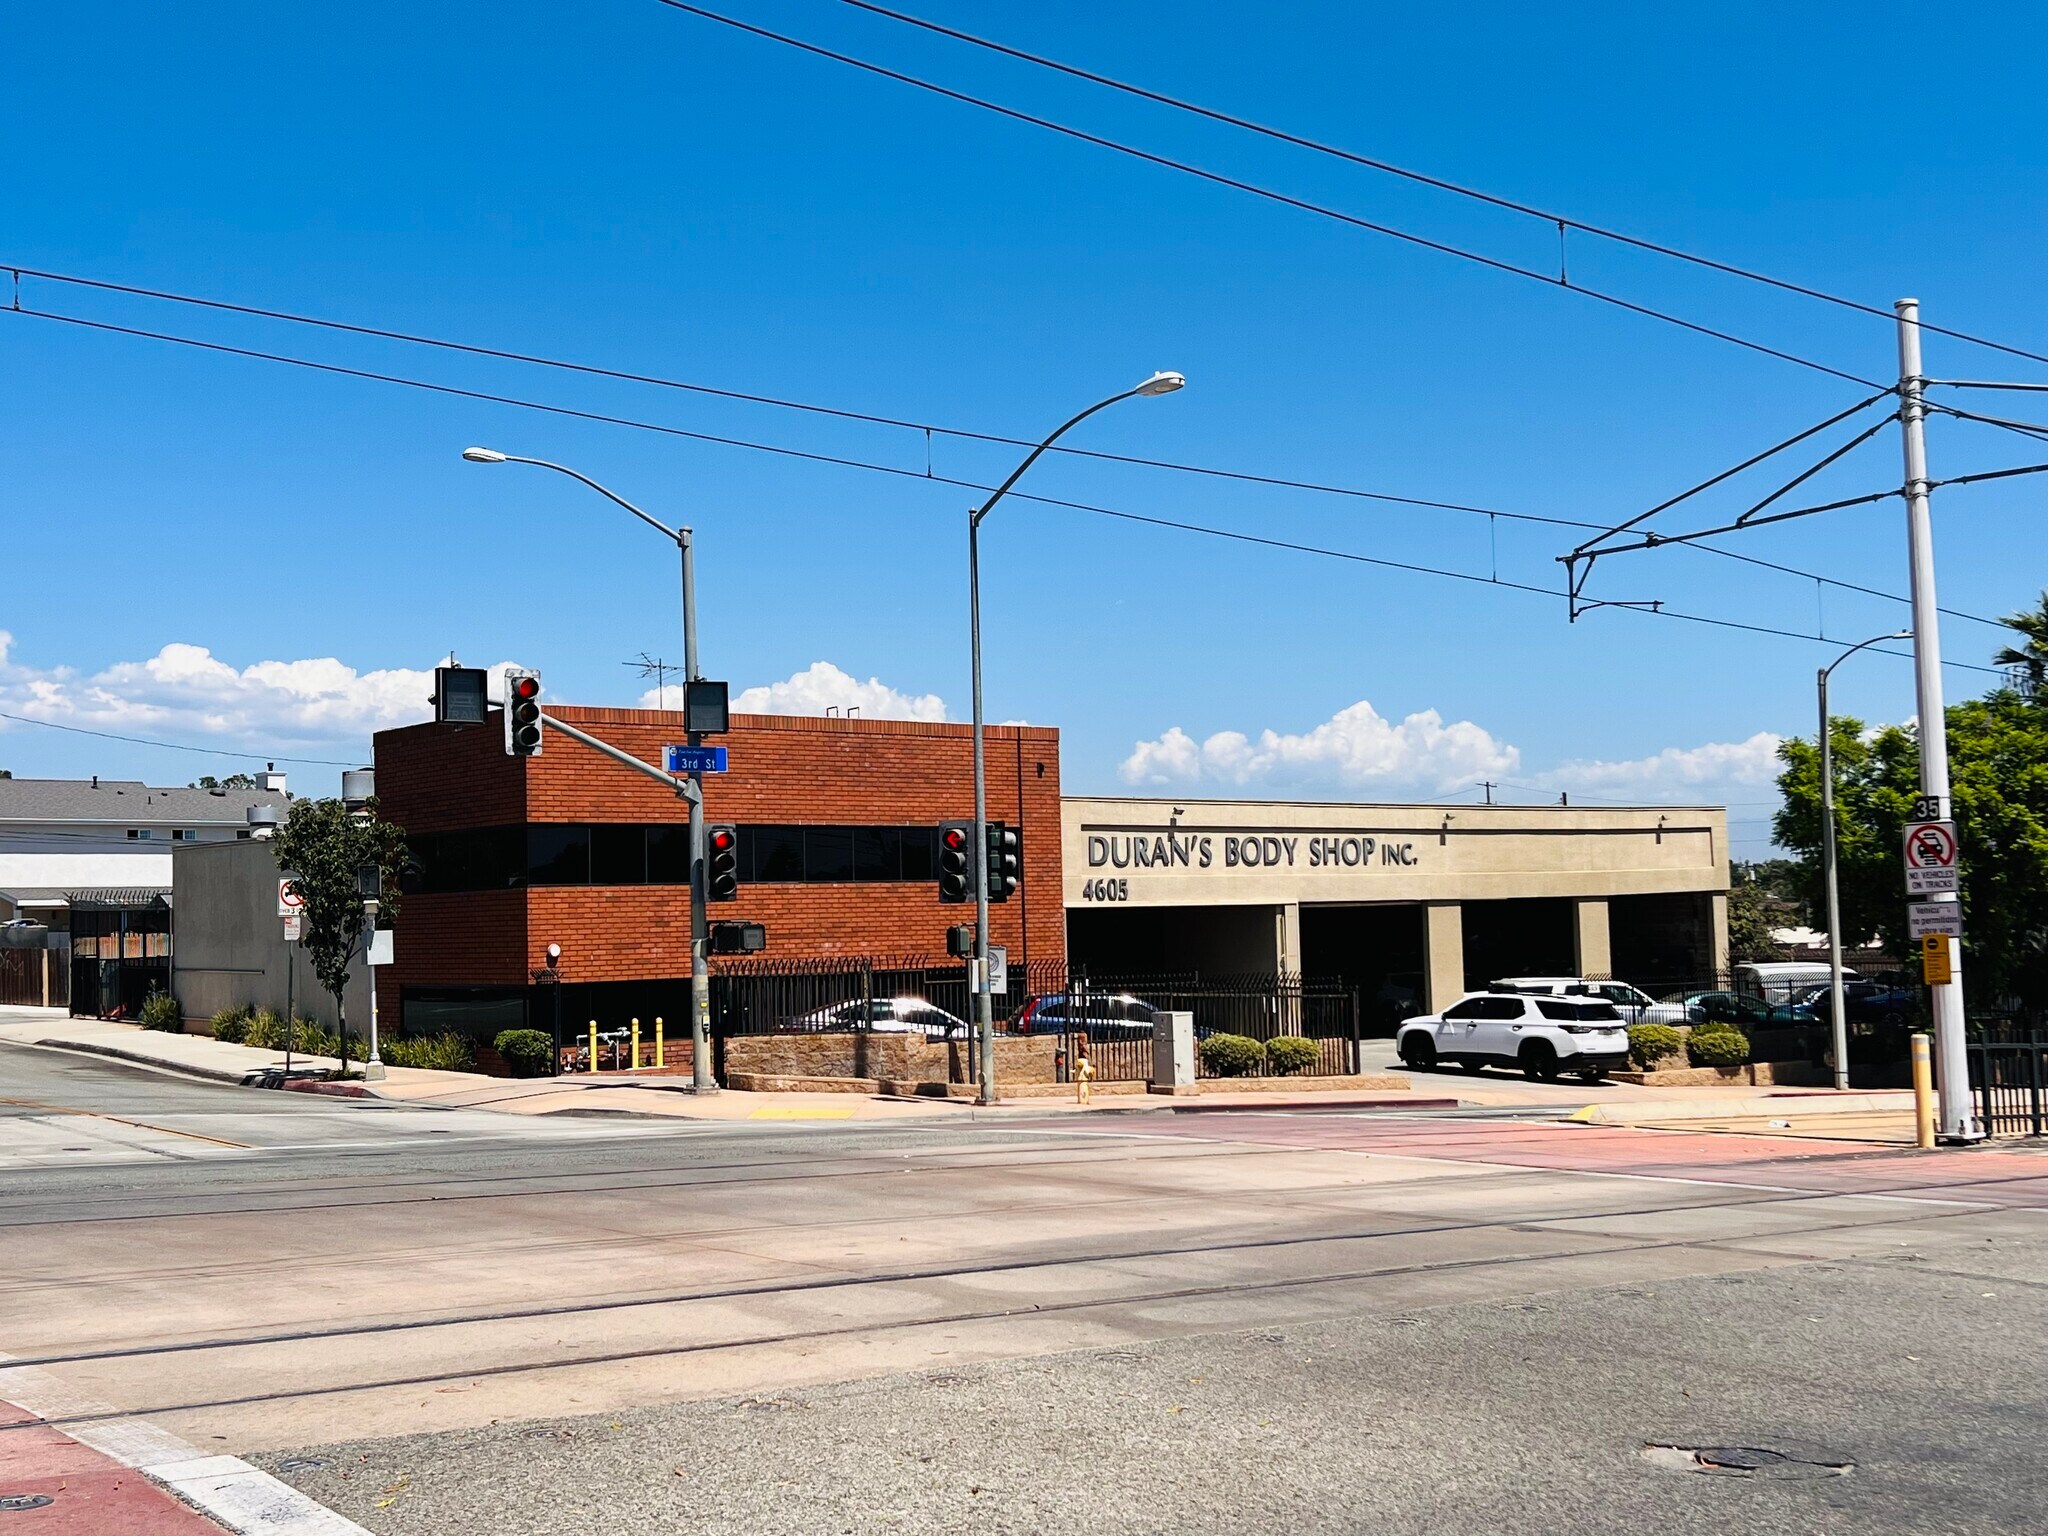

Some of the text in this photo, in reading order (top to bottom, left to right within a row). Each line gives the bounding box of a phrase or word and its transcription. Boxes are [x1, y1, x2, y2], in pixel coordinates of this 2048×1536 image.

[681, 758, 716, 770] 3rd St
[1916, 800, 1939, 818] 35
[1088, 835, 1418, 868] DURAN'S BODY SHOP INC.
[1921, 870, 1955, 879] VEHICLES
[1082, 878, 1129, 901] 4605
[1911, 880, 1953, 889] ON TRACKS
